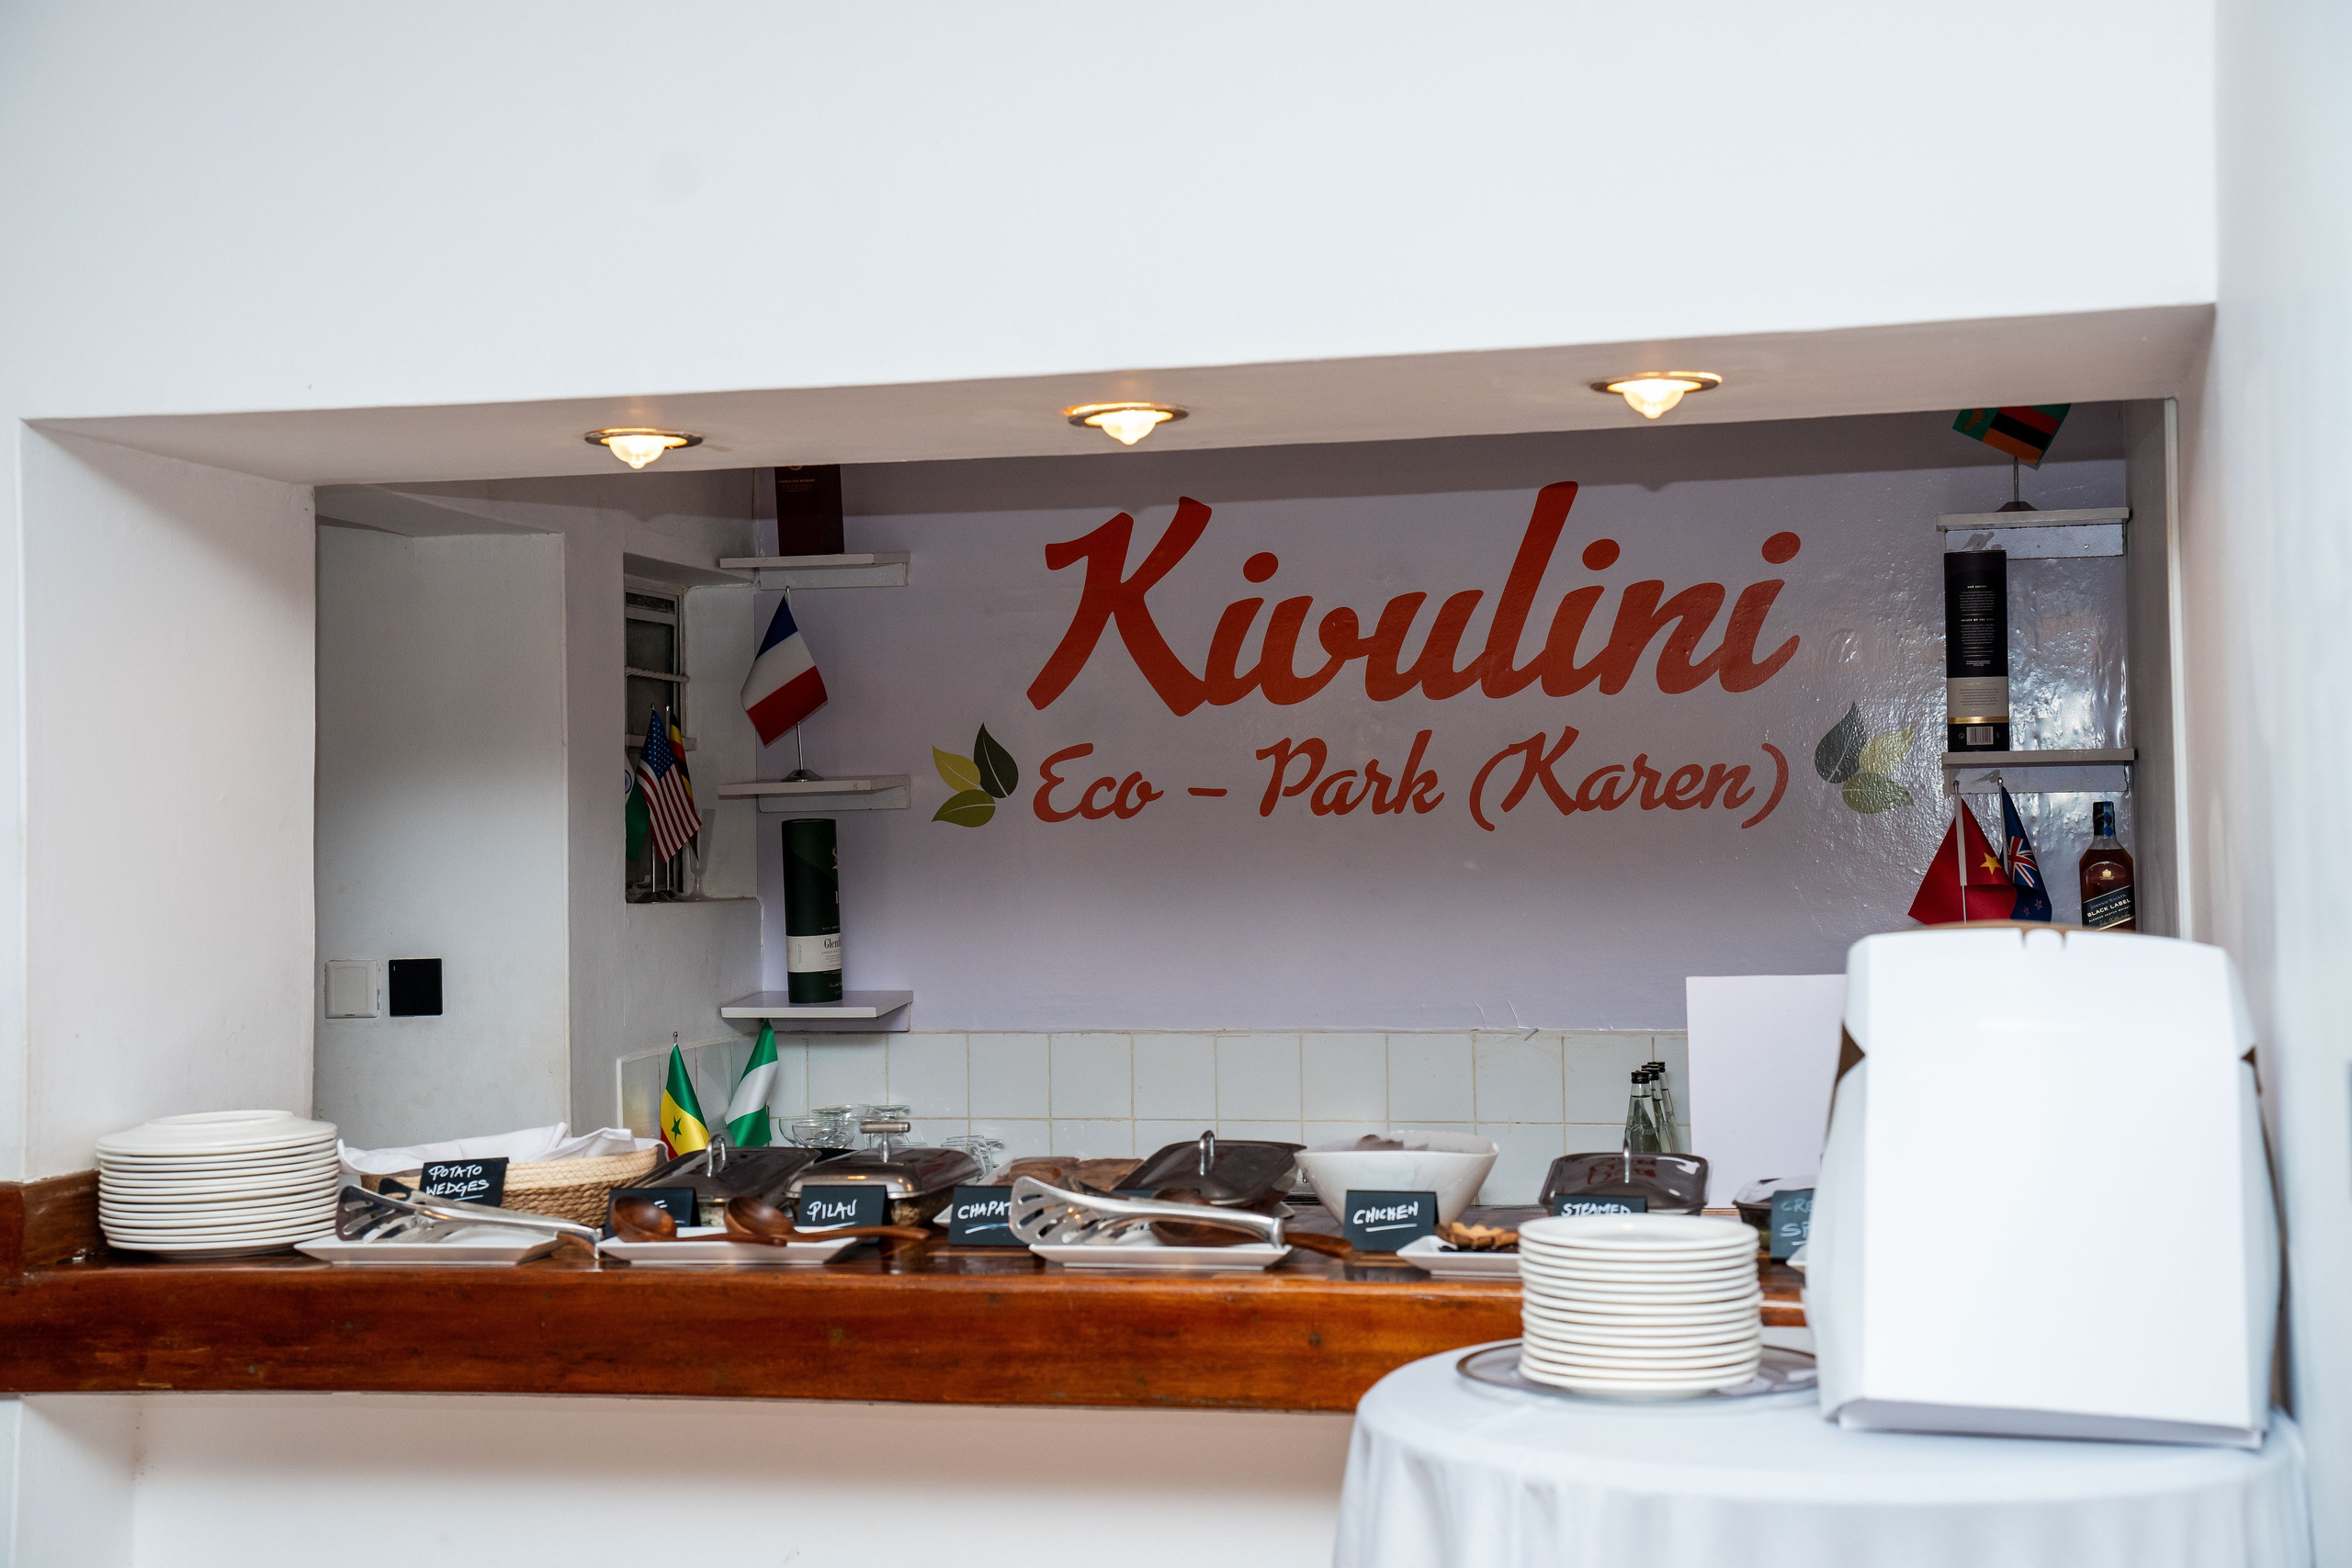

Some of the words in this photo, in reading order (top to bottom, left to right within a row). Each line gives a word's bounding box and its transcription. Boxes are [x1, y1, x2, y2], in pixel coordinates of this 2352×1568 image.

[1026, 480, 1802, 717] Kivulini
[1033, 742, 1165, 823] Eco
[1256, 728, 1445, 818] Park
[1469, 725, 1789, 832] (Karen)
[2087, 907, 2109, 917] BLACK
[2109, 898, 2131, 908] LABEL
[428, 1164, 482, 1181] POTATO
[425, 1179, 490, 1197] WEDGES
[807, 1199, 857, 1222] PILAU
[1352, 1201, 1419, 1224] CHICKEN
[1561, 1202, 1632, 1217] STEAMED
